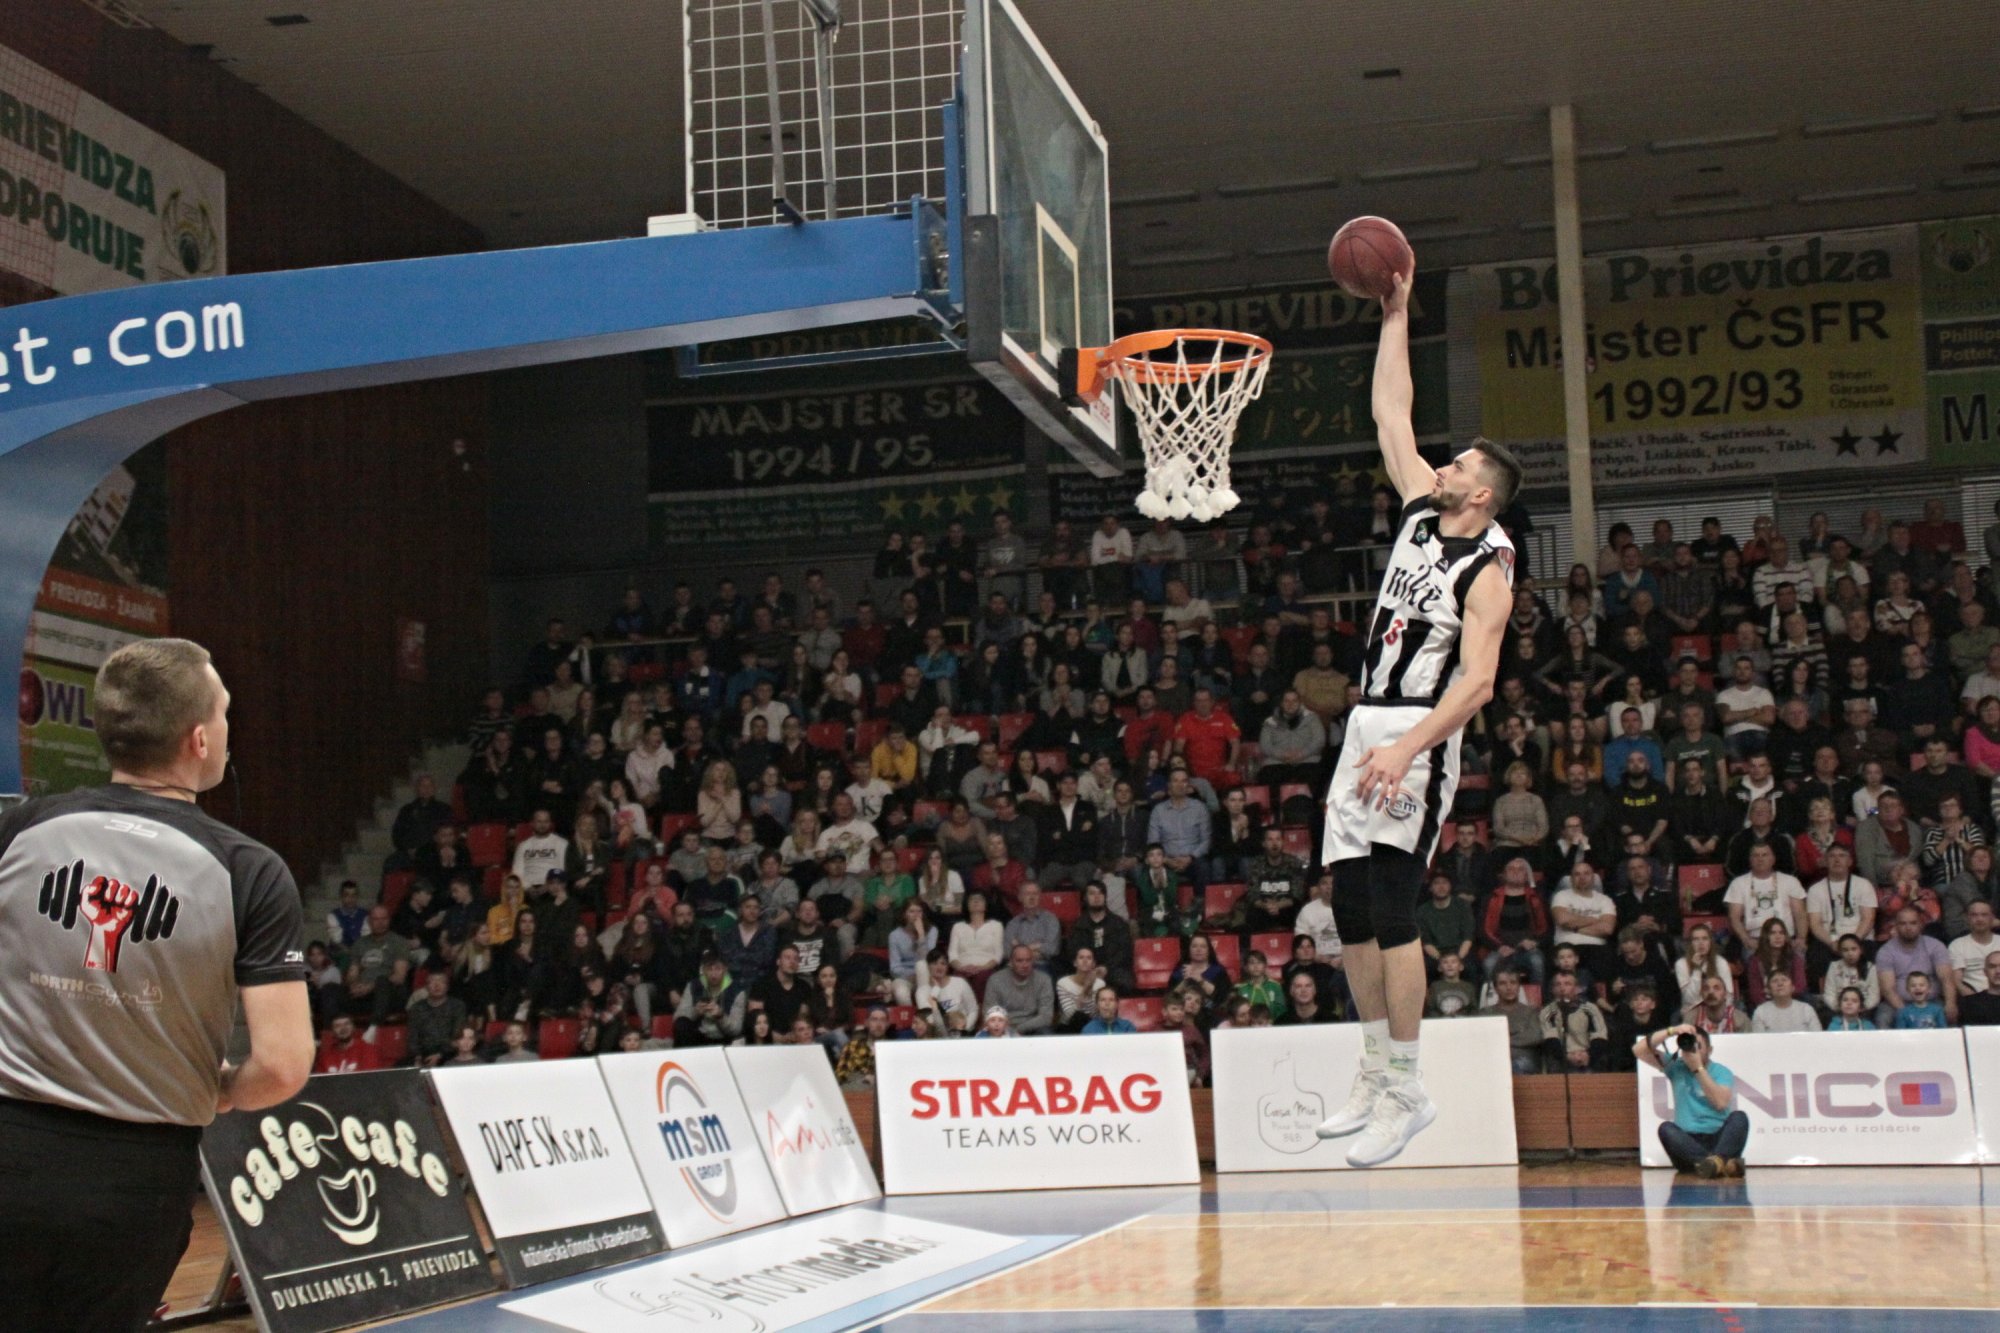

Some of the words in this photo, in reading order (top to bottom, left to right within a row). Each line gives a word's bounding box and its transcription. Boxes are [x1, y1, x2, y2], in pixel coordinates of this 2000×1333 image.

[1608, 236, 1893, 303] Prievidza
[1505, 317, 1709, 374] Mjster
[1726, 299, 1890, 351] ČSFR
[690, 391, 907, 437] MAJSTER
[922, 385, 982, 420] SR
[1594, 368, 1805, 423] 1992/93
[1942, 392, 2000, 444] M
[910, 1073, 1163, 1120] STRABAG
[657, 1113, 732, 1161] msm
[942, 1125, 1037, 1149] TEAMS
[1048, 1122, 1142, 1145] WORK.
[697, 1162, 723, 1180] GROUP
[271, 1272, 377, 1311] DUKLIANSKA
[402, 1249, 480, 1281] PRIEVIDZA
